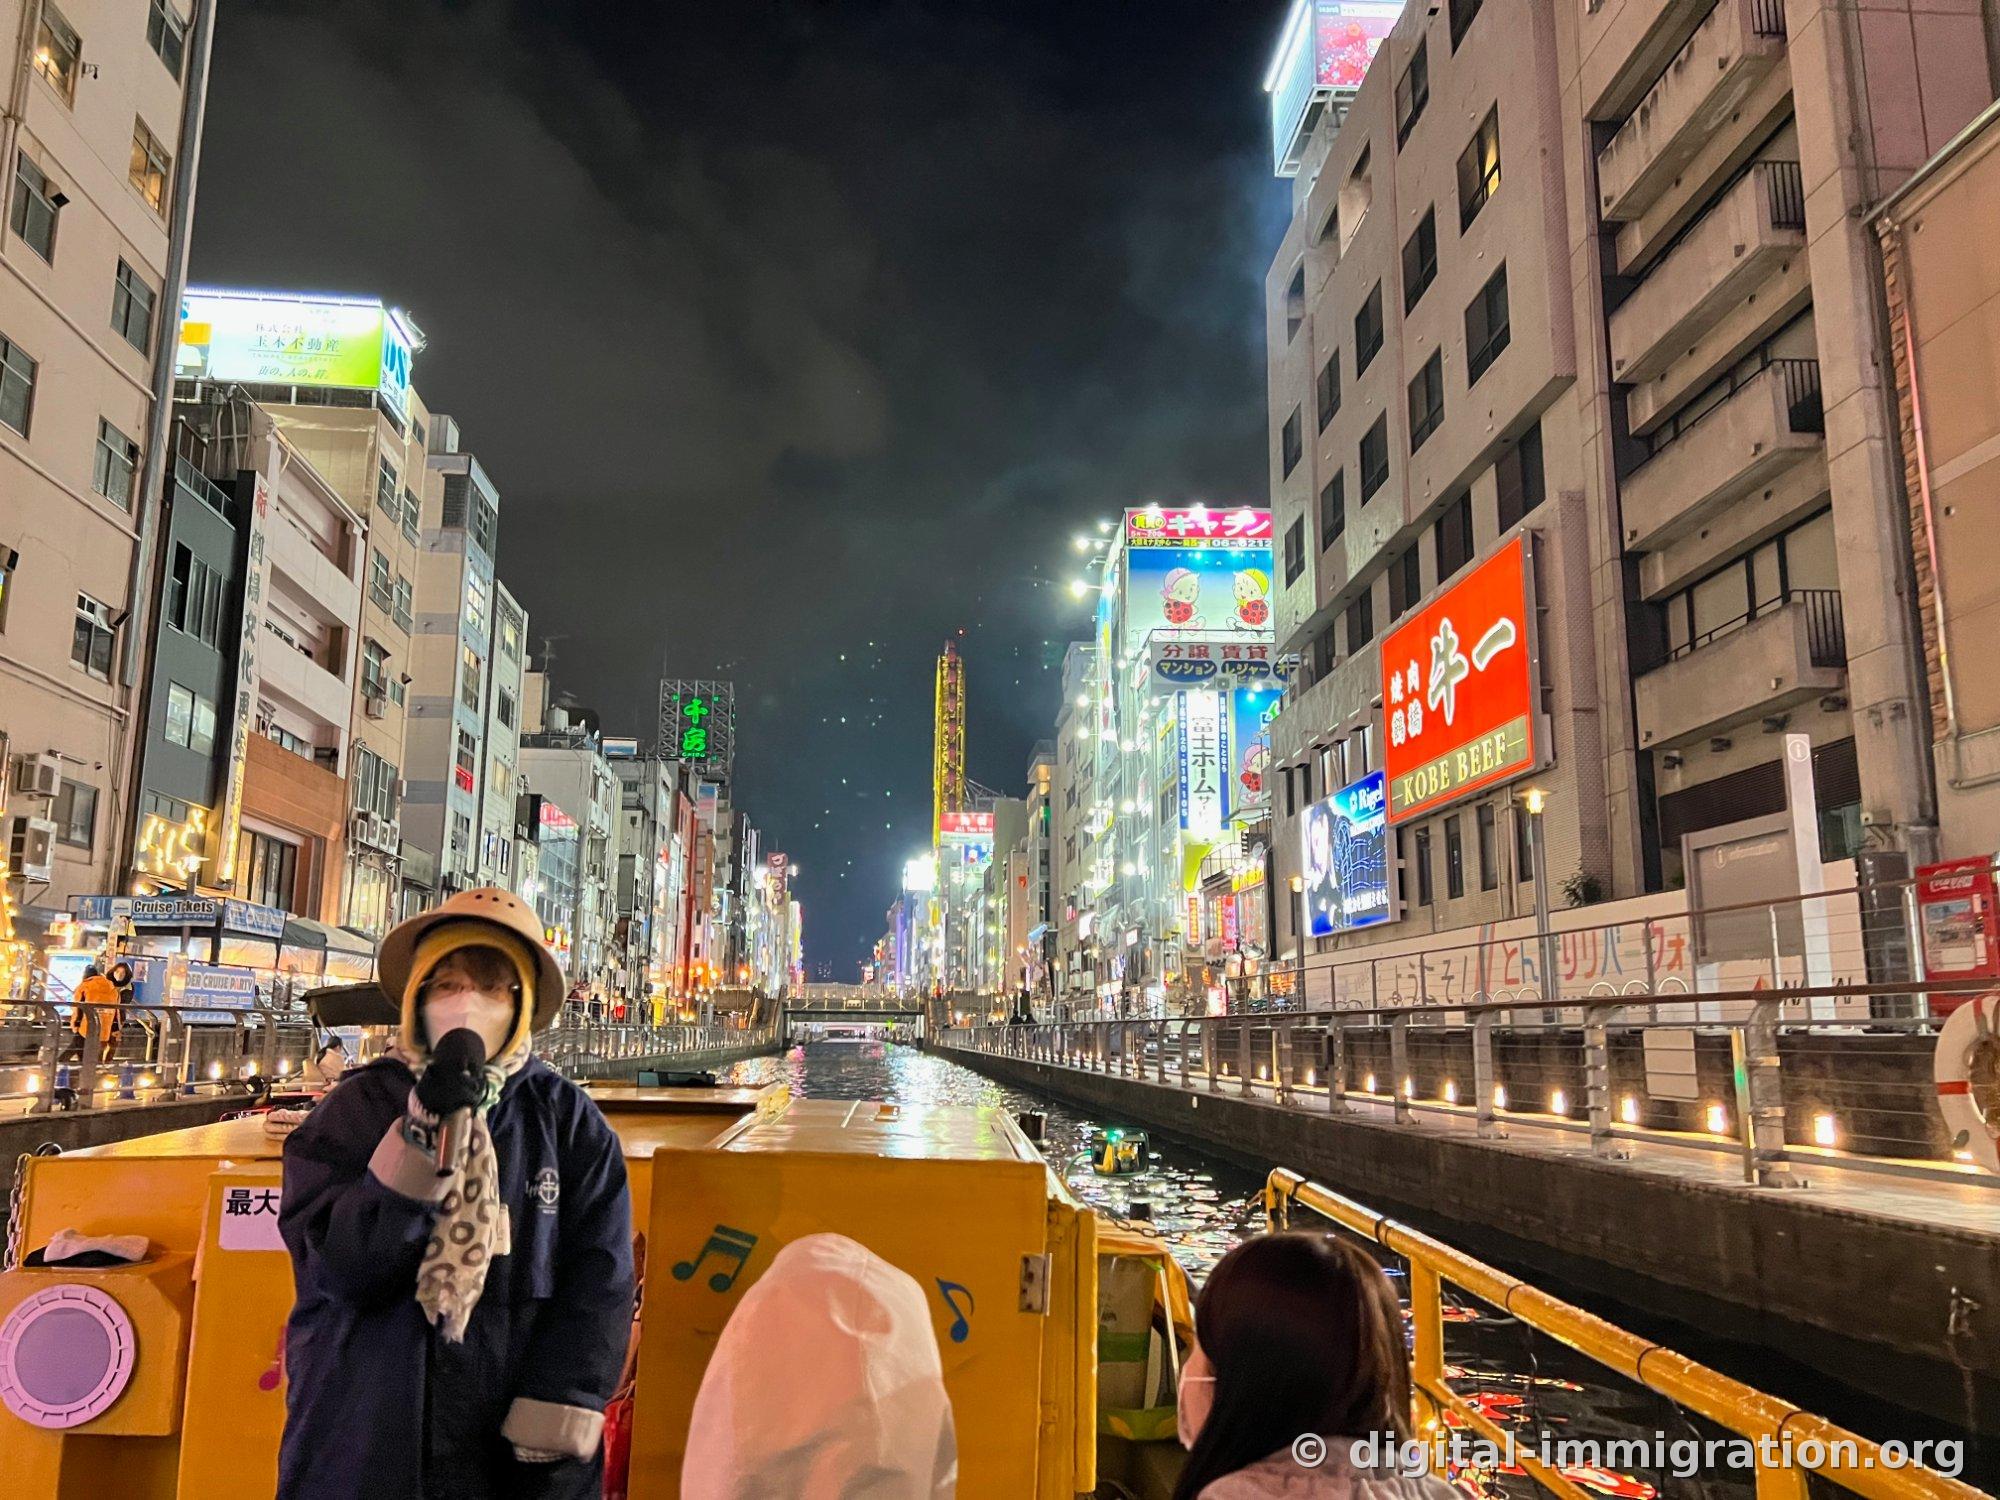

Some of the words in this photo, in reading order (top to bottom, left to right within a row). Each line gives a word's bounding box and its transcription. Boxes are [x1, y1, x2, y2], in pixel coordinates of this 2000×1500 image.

[1162, 644, 1210, 659] 分譲
[1221, 645, 1268, 660] 賃貸
[1160, 662, 1215, 675] マンション
[1225, 664, 1269, 676] レジャー
[1428, 617, 1516, 727] 牛一
[683, 698, 708, 751] 千房
[1403, 762, 1450, 806] KOBE
[1457, 731, 1507, 784] BEEF
[134, 901, 173, 913] Cruise
[176, 901, 214, 913] Tkets
[203, 974, 230, 990] CRUISE
[231, 976, 254, 992] PARTY
[225, 1189, 280, 1216] 最大
